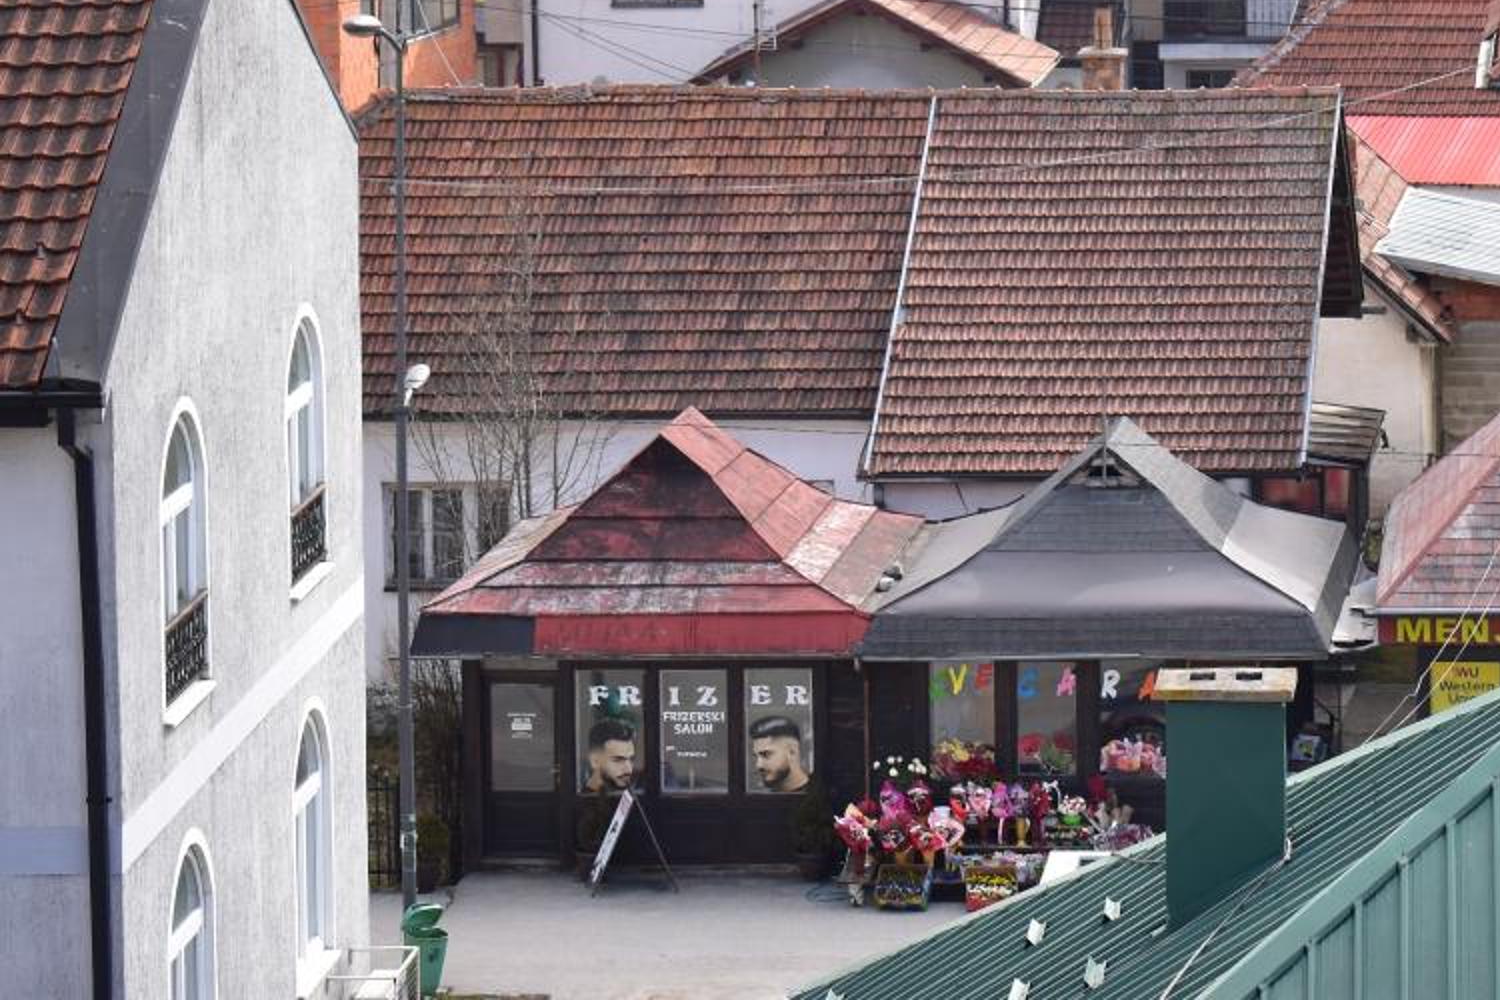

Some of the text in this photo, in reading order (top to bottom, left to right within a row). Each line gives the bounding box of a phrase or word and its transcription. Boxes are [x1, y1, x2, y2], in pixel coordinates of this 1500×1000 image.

[1440, 681, 1495, 692] Western
[663, 711, 726, 722] FRIZERSKI
[673, 723, 714, 735] SALON
